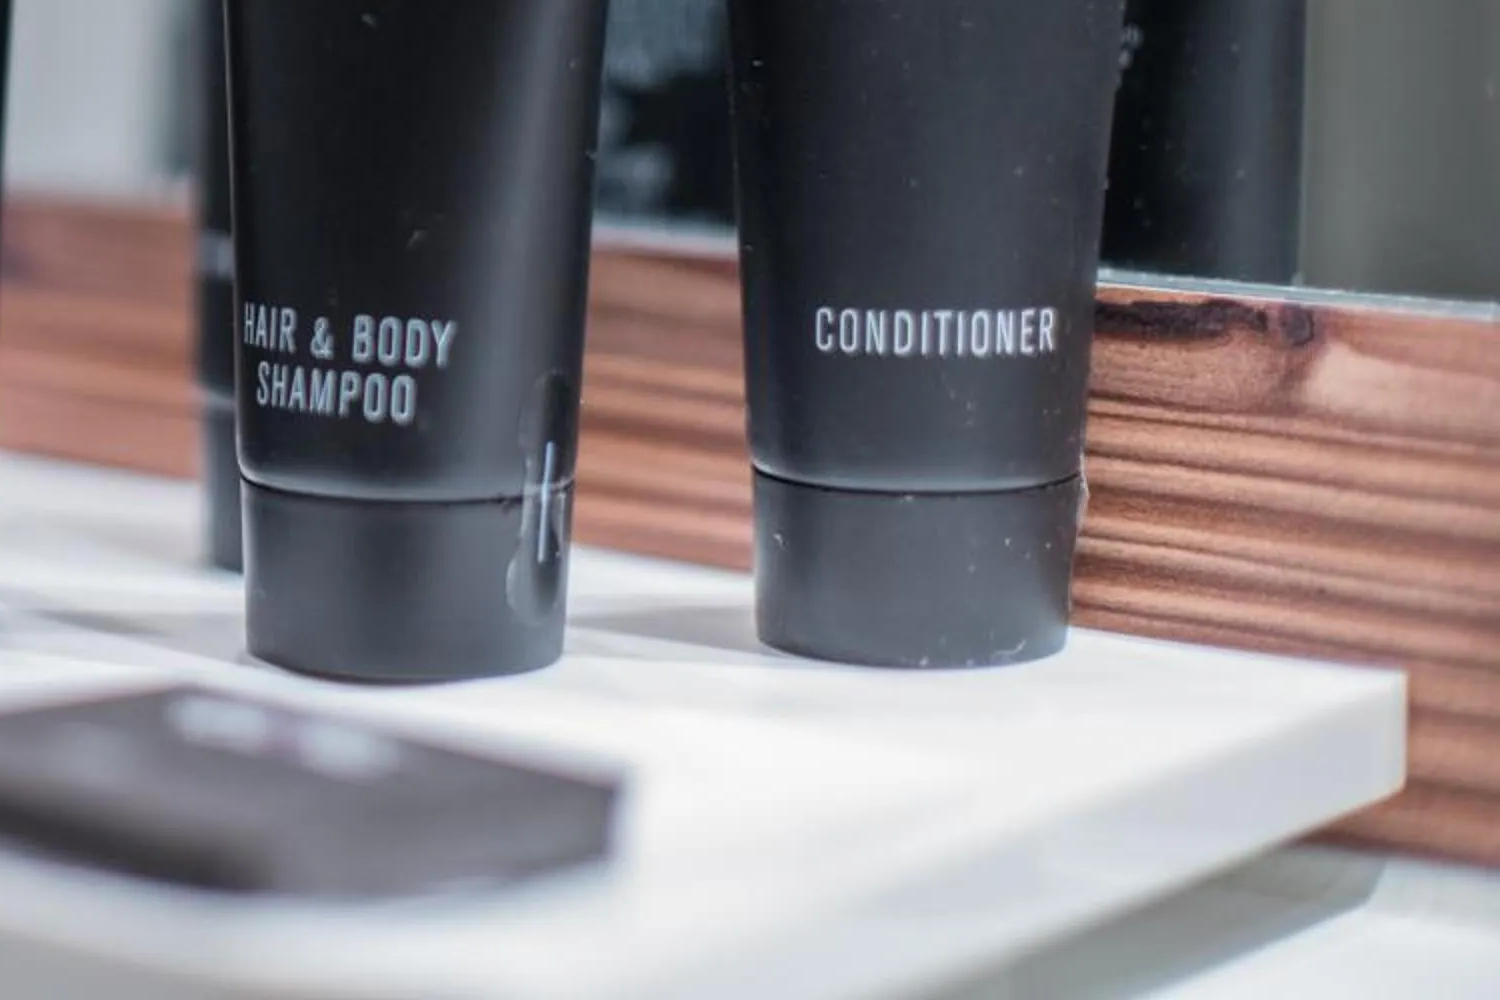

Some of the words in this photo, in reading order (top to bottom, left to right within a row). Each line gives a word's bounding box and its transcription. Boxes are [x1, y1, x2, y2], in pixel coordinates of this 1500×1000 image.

[243, 302, 297, 353] HAIR
[310, 316, 334, 360] &
[352, 314, 457, 368] BODY
[814, 306, 1056, 355] CONDITIONER
[256, 360, 417, 426] SHAMPOO
